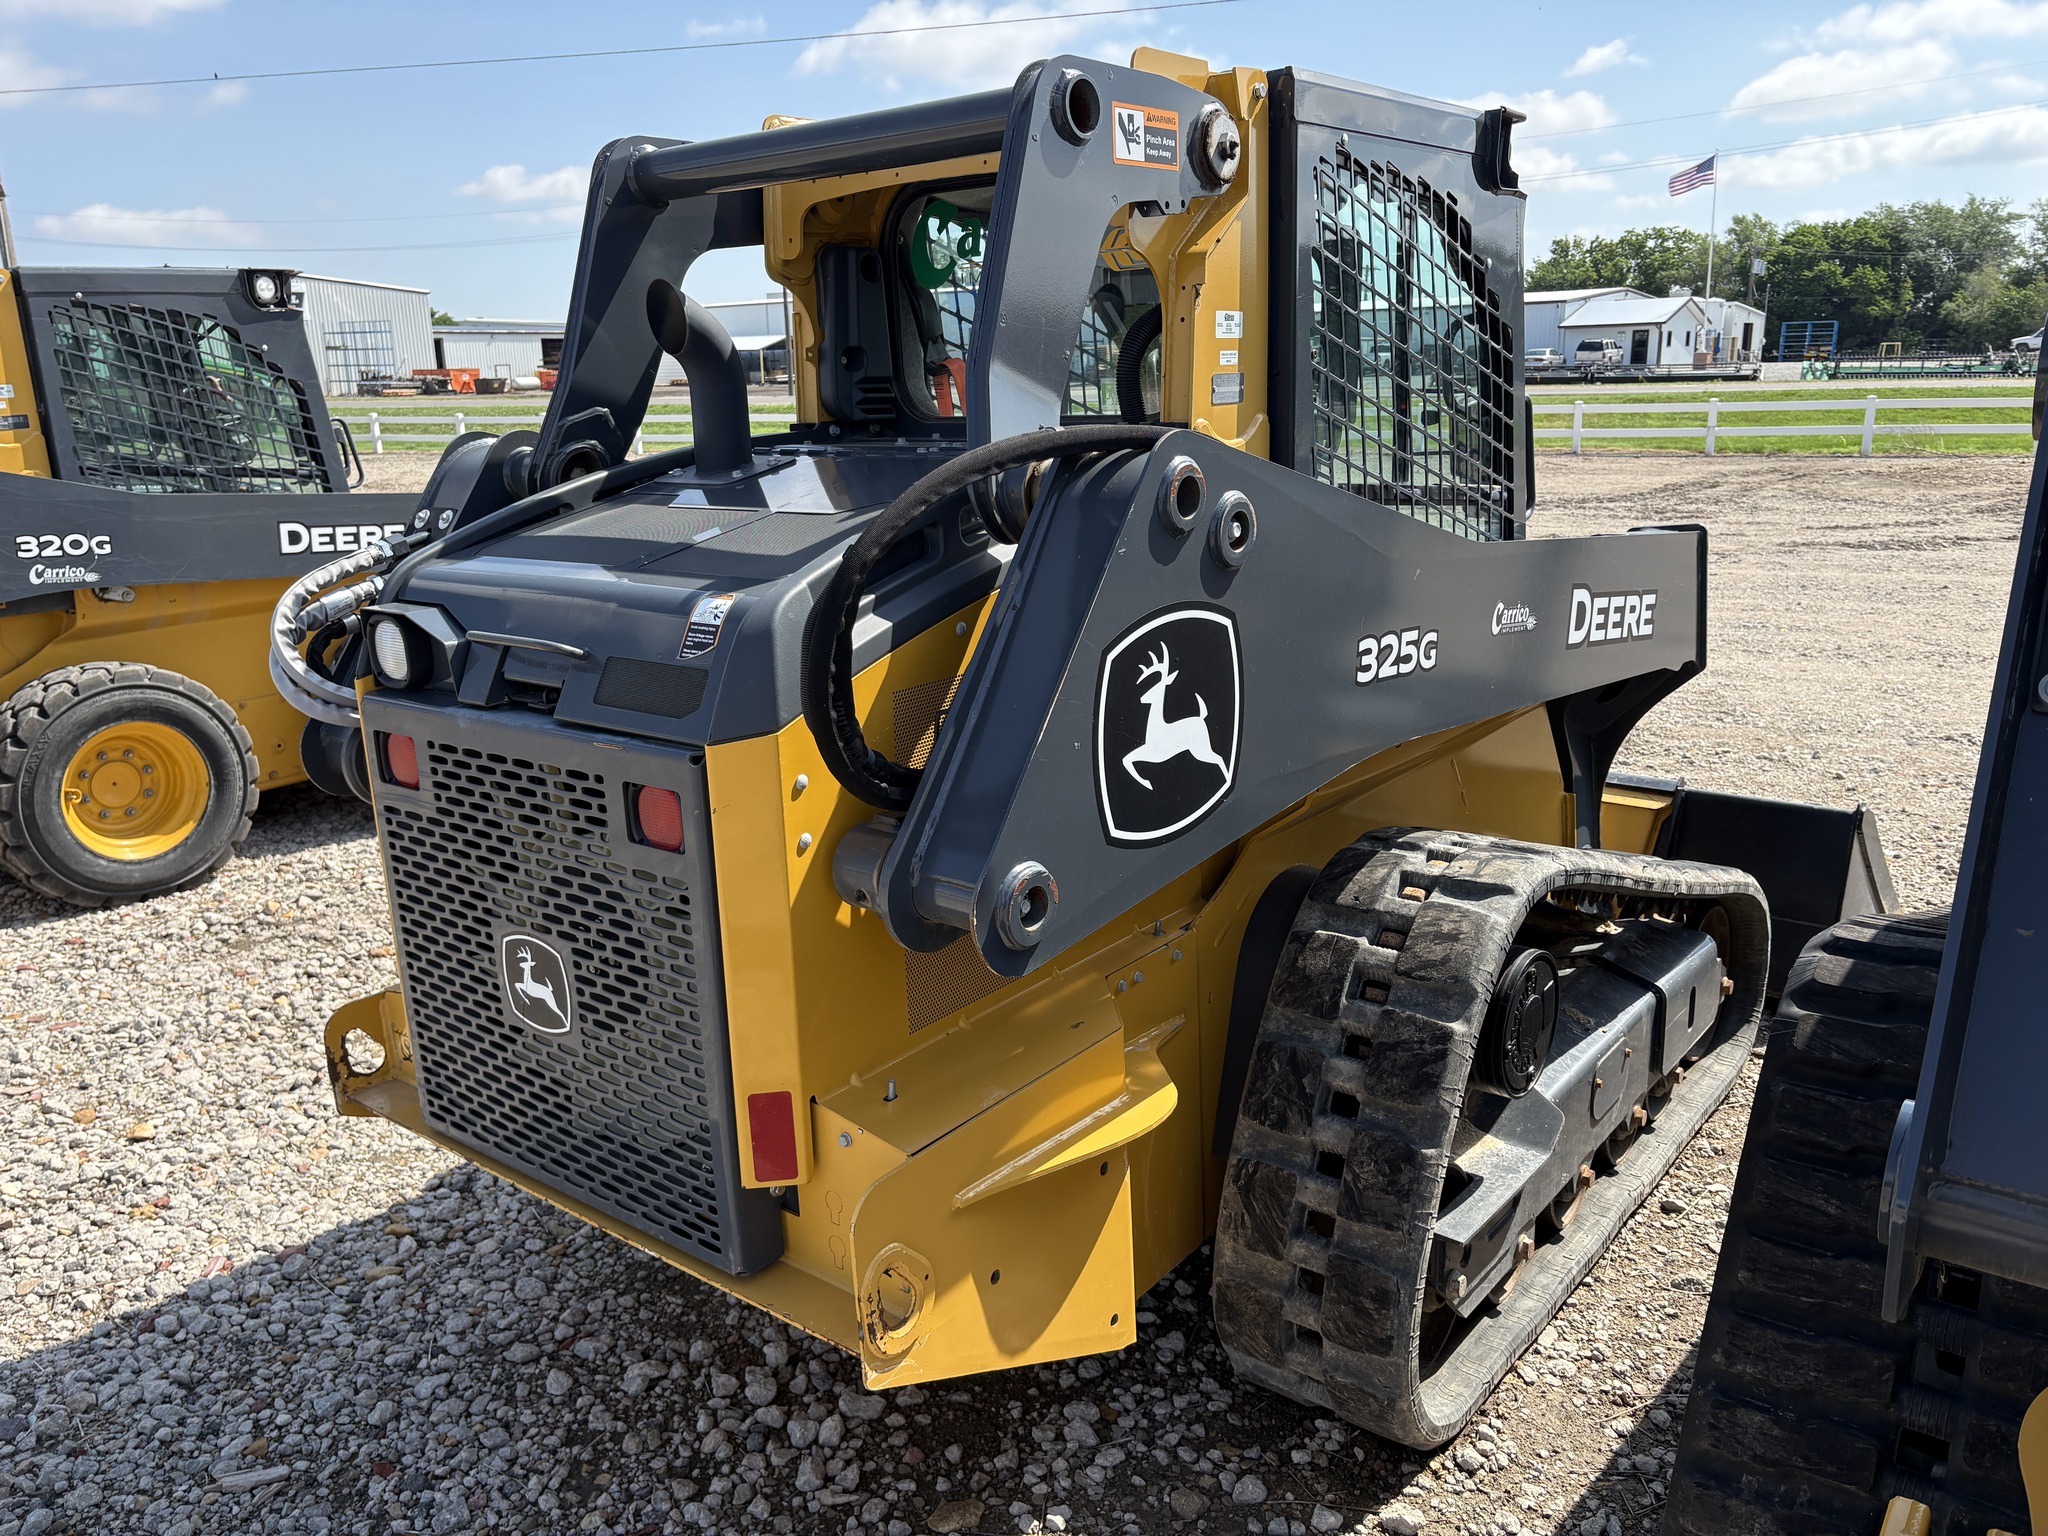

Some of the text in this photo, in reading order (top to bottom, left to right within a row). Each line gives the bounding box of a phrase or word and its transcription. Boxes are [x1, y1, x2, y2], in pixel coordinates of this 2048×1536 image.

[1151, 113, 1176, 126] WARNING
[1146, 133, 1176, 147] Pinch Area
[1146, 148, 1172, 160] Keep Away
[911, 199, 982, 290] Ca
[15, 534, 112, 559] 320G
[29, 563, 85, 585] Carrico
[44, 576, 85, 584] IMPLEMENT
[1491, 599, 1530, 636] Carrico
[1567, 587, 1657, 646] DEERE
[1500, 624, 1527, 634] IMPLEMENT
[1356, 628, 1439, 684] 325G
[21, 731, 52, 808] ALAXY
